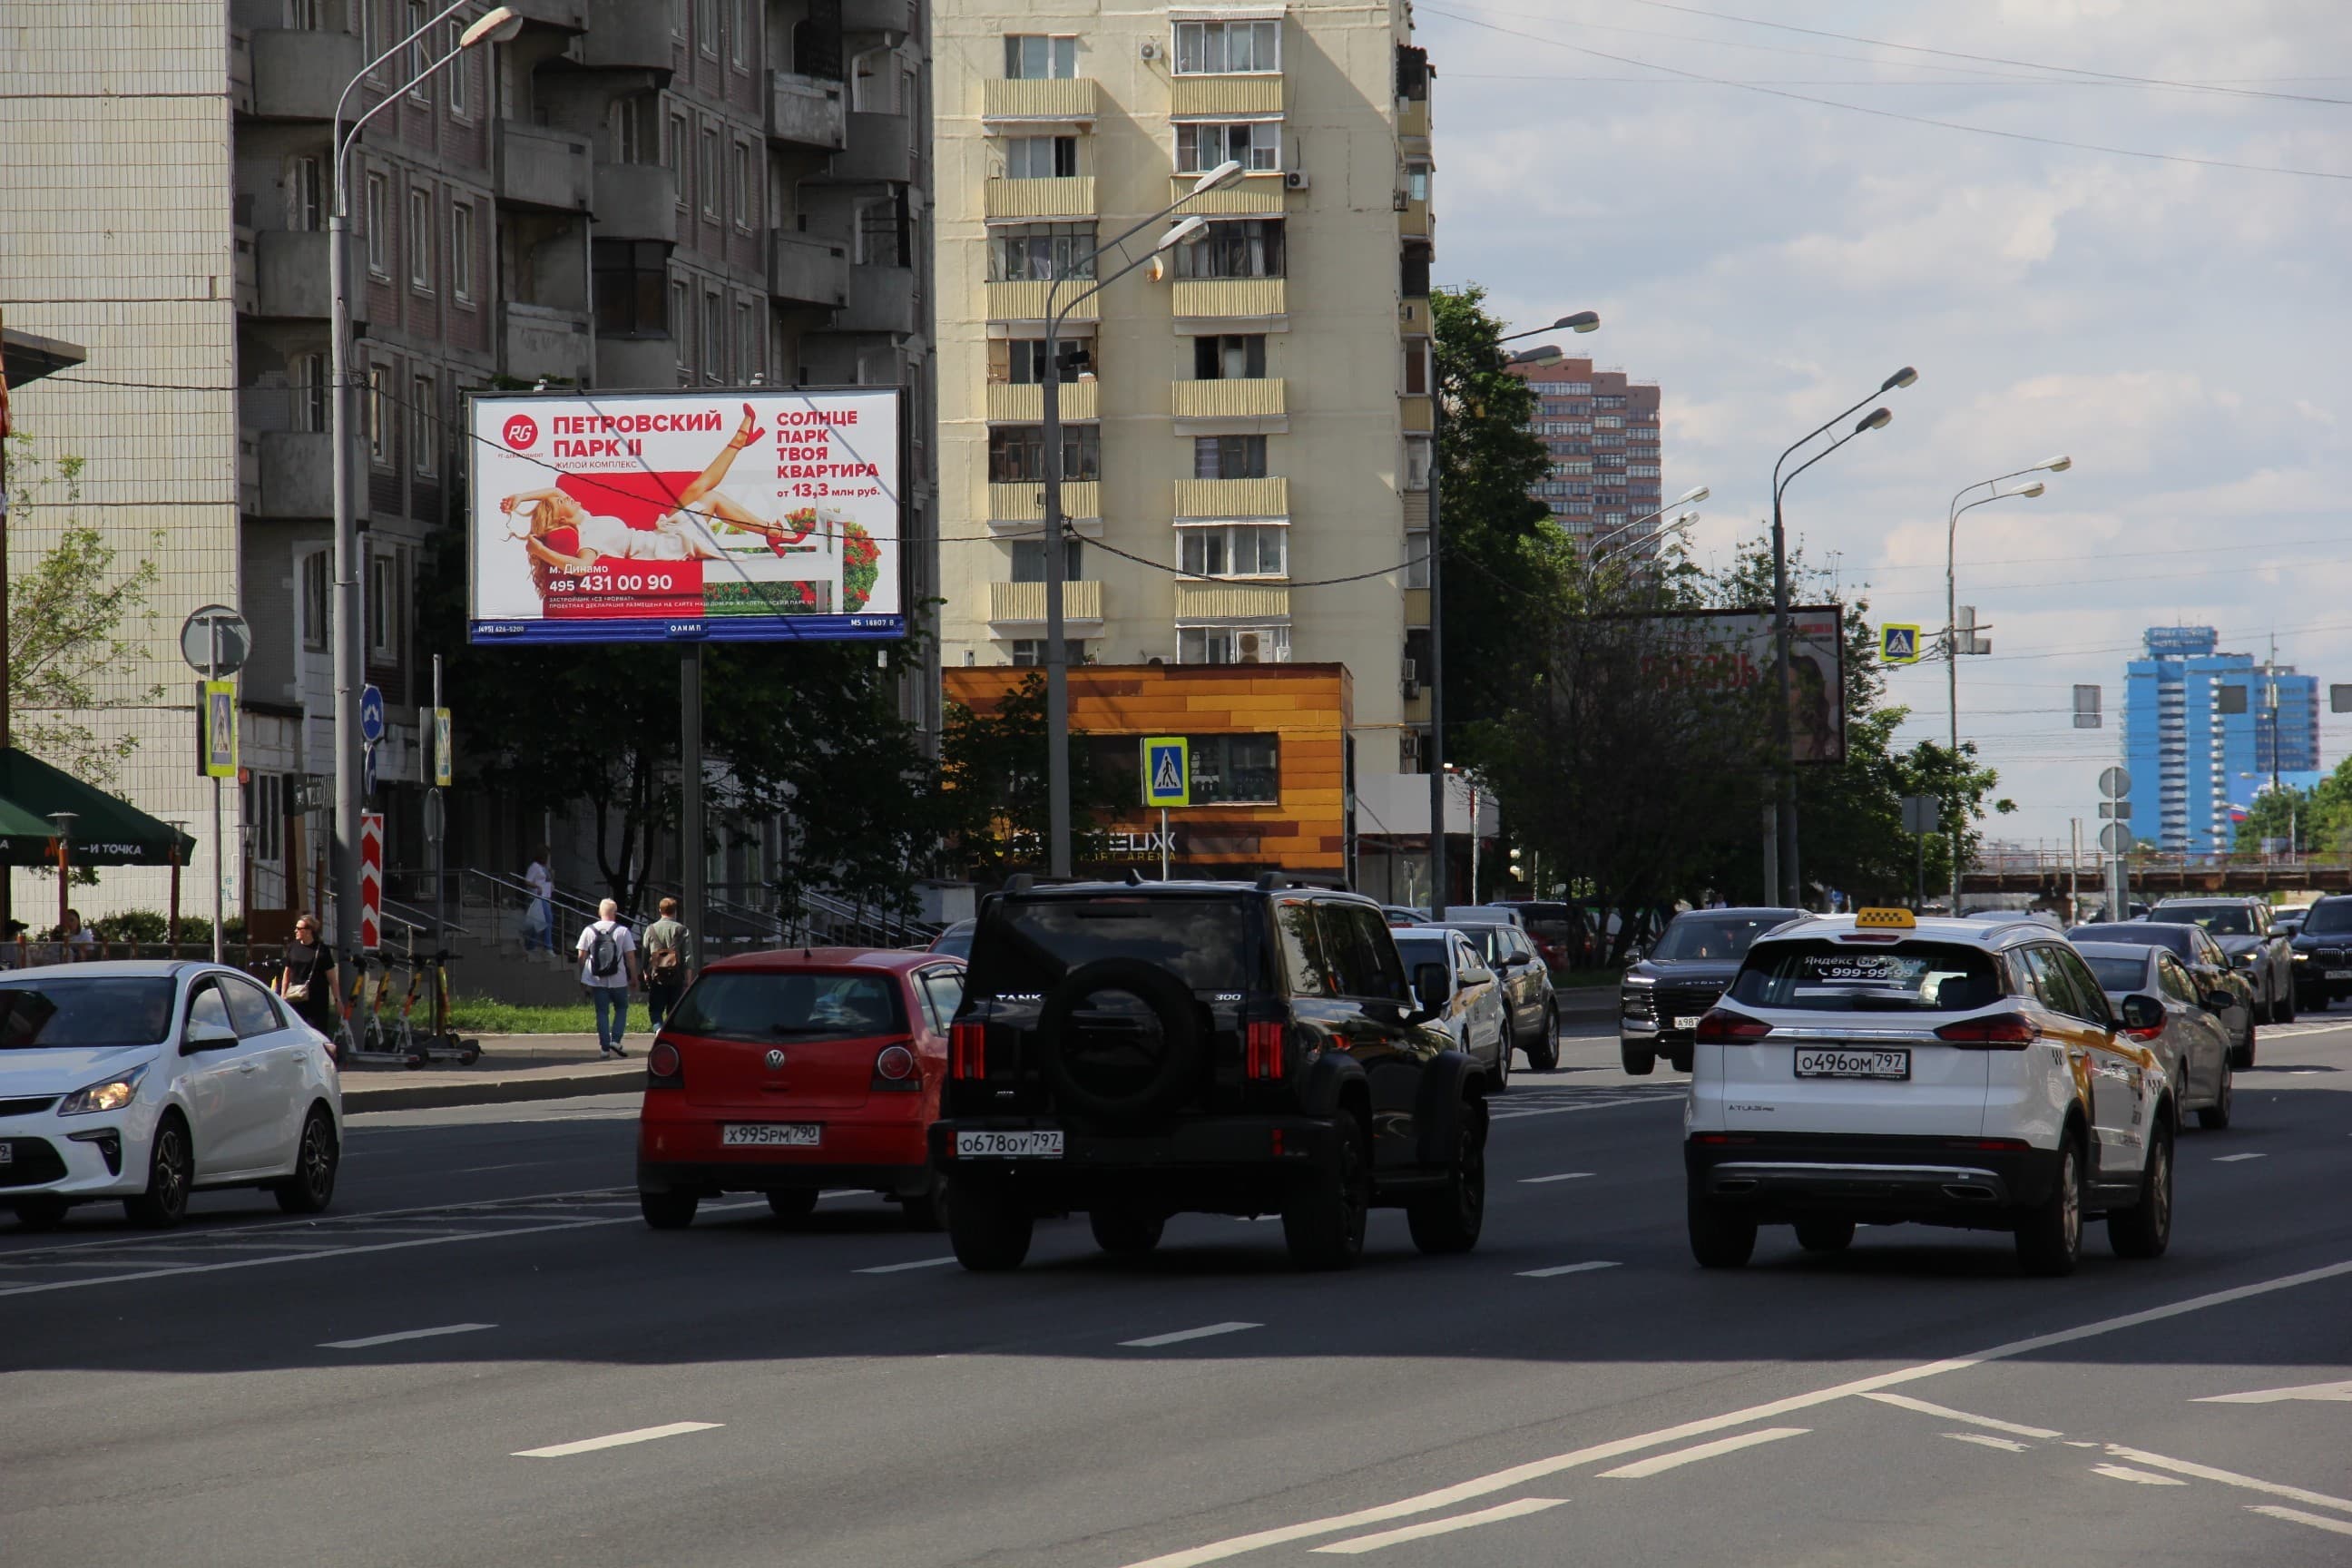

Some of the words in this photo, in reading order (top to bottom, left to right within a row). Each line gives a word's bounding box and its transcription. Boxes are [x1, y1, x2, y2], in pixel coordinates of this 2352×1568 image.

[553, 409, 722, 434] ПЕТРОВСКИЙ
[777, 410, 858, 426] СОЛНЦЕ
[777, 429, 829, 443] ПАРК
[554, 439, 621, 457] ПАРК
[777, 446, 828, 461] ТВОЯ
[555, 460, 587, 469] ЖИЛОЙ
[590, 460, 638, 468] КОМПЛЕКС
[777, 464, 878, 478] КВАРТИРА
[792, 483, 828, 499] 13,3
[831, 488, 854, 496] млн
[858, 486, 880, 497] руб.
[564, 564, 608, 574] Динамо
[549, 581, 574, 592] 495
[580, 575, 612, 591] 431
[617, 574, 642, 590] 00
[647, 574, 672, 590] 90
[102, 844, 142, 855] ТОЧКА
[1804, 956, 1854, 966] Яндекс
[1831, 967, 1914, 978] 999-99-99
[995, 994, 1042, 1002] TANK
[1875, 1054, 1902, 1068] 797
[792, 1126, 817, 1138] 790
[1032, 1132, 1059, 1147] 797
